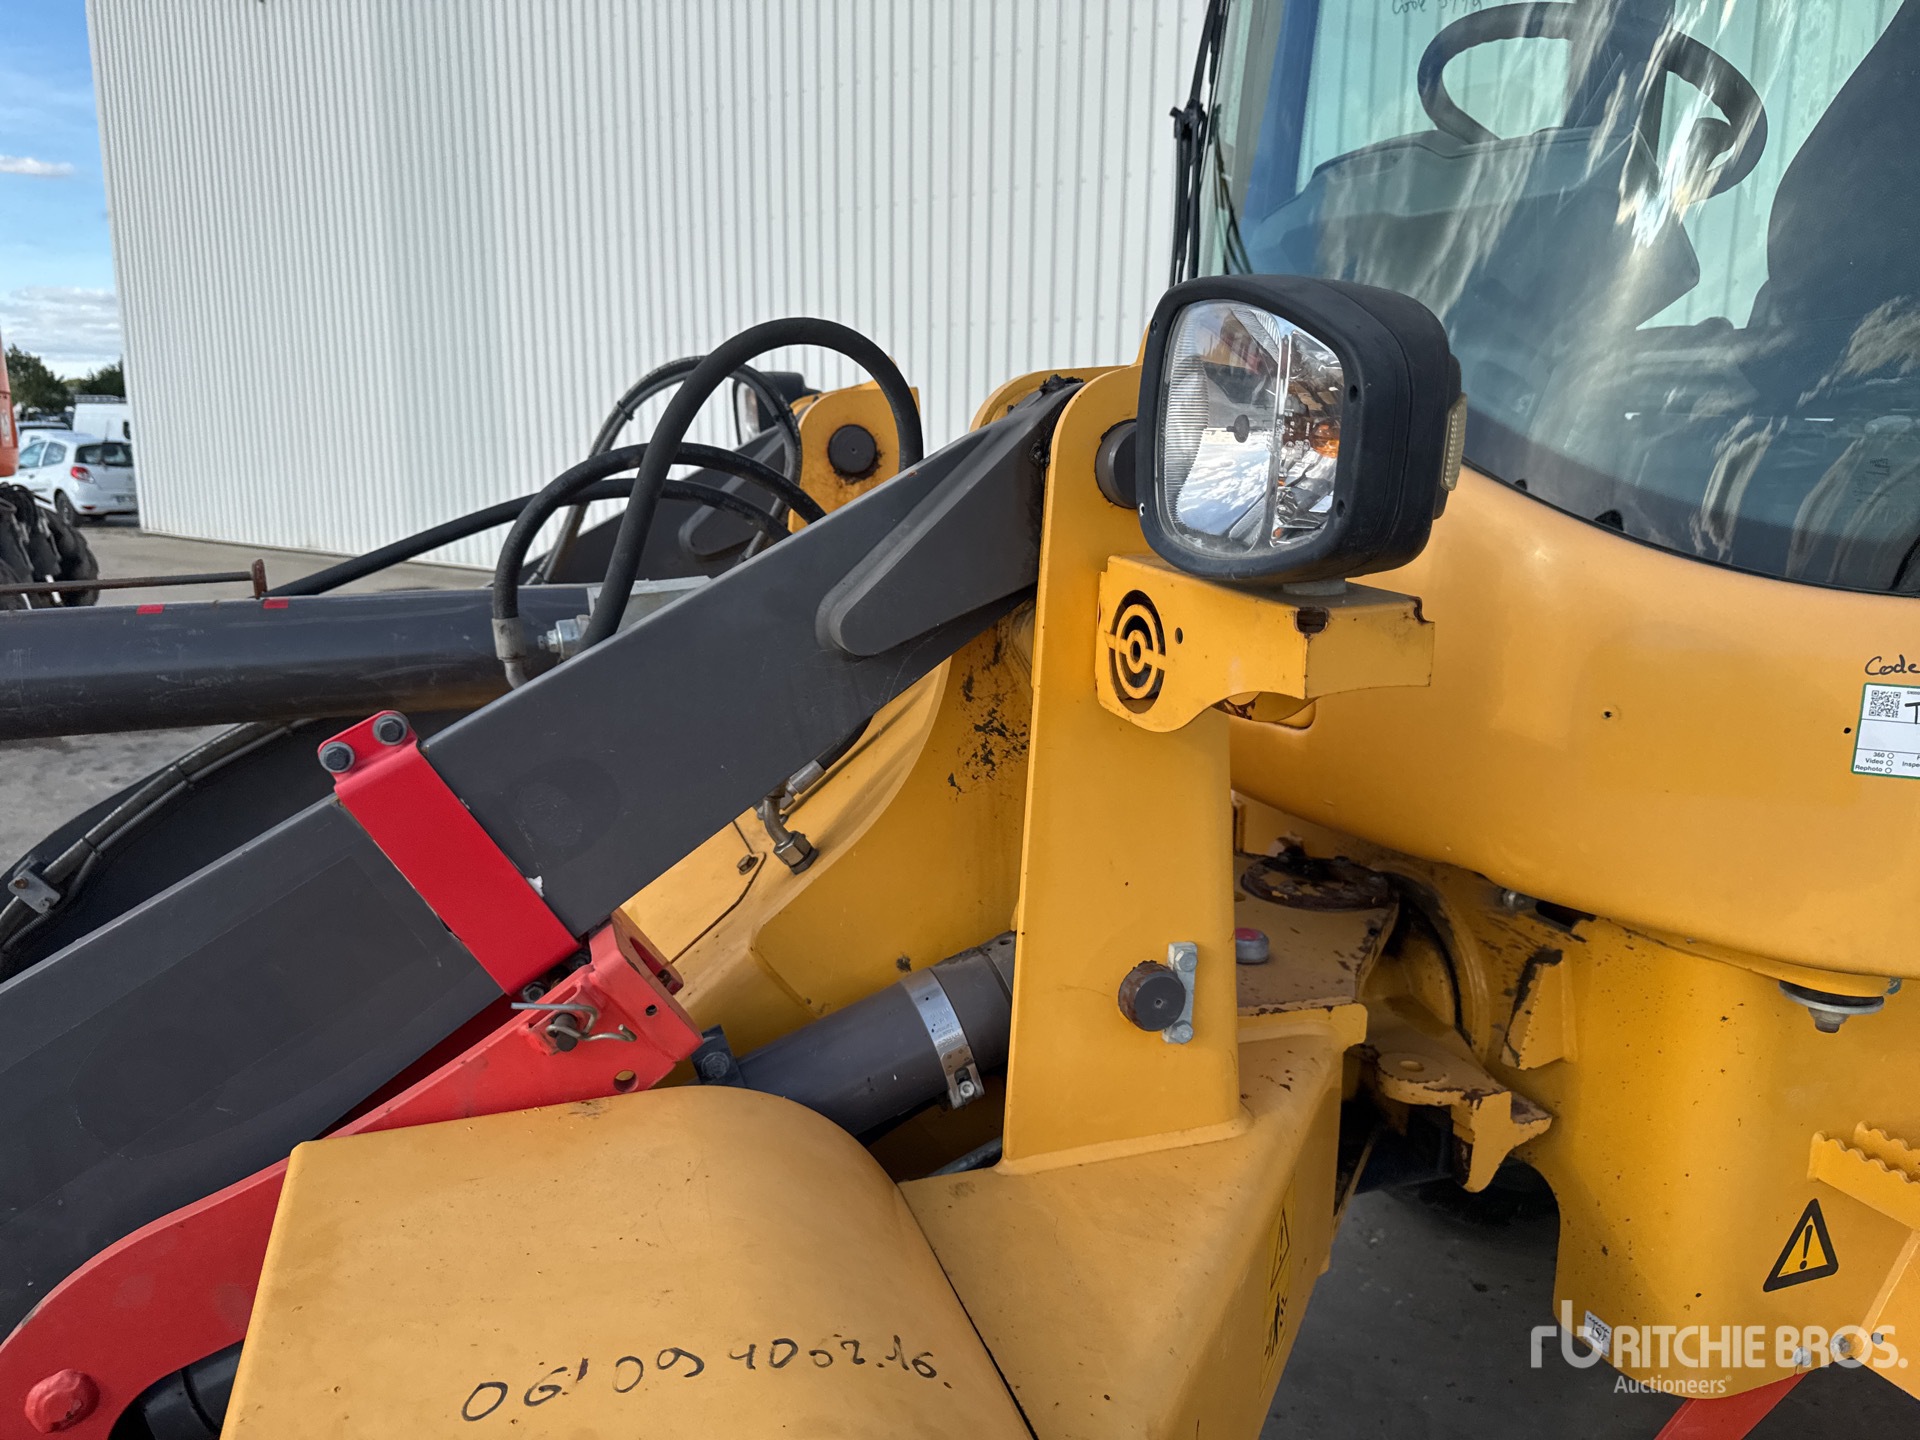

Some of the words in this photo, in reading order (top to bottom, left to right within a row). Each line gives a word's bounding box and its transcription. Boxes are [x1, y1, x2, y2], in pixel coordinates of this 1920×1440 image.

[1864, 654, 1920, 676] Code
[1873, 751, 1885, 759] 360
[1865, 758, 1884, 766] Video
[1855, 764, 1883, 773] Rephoto
